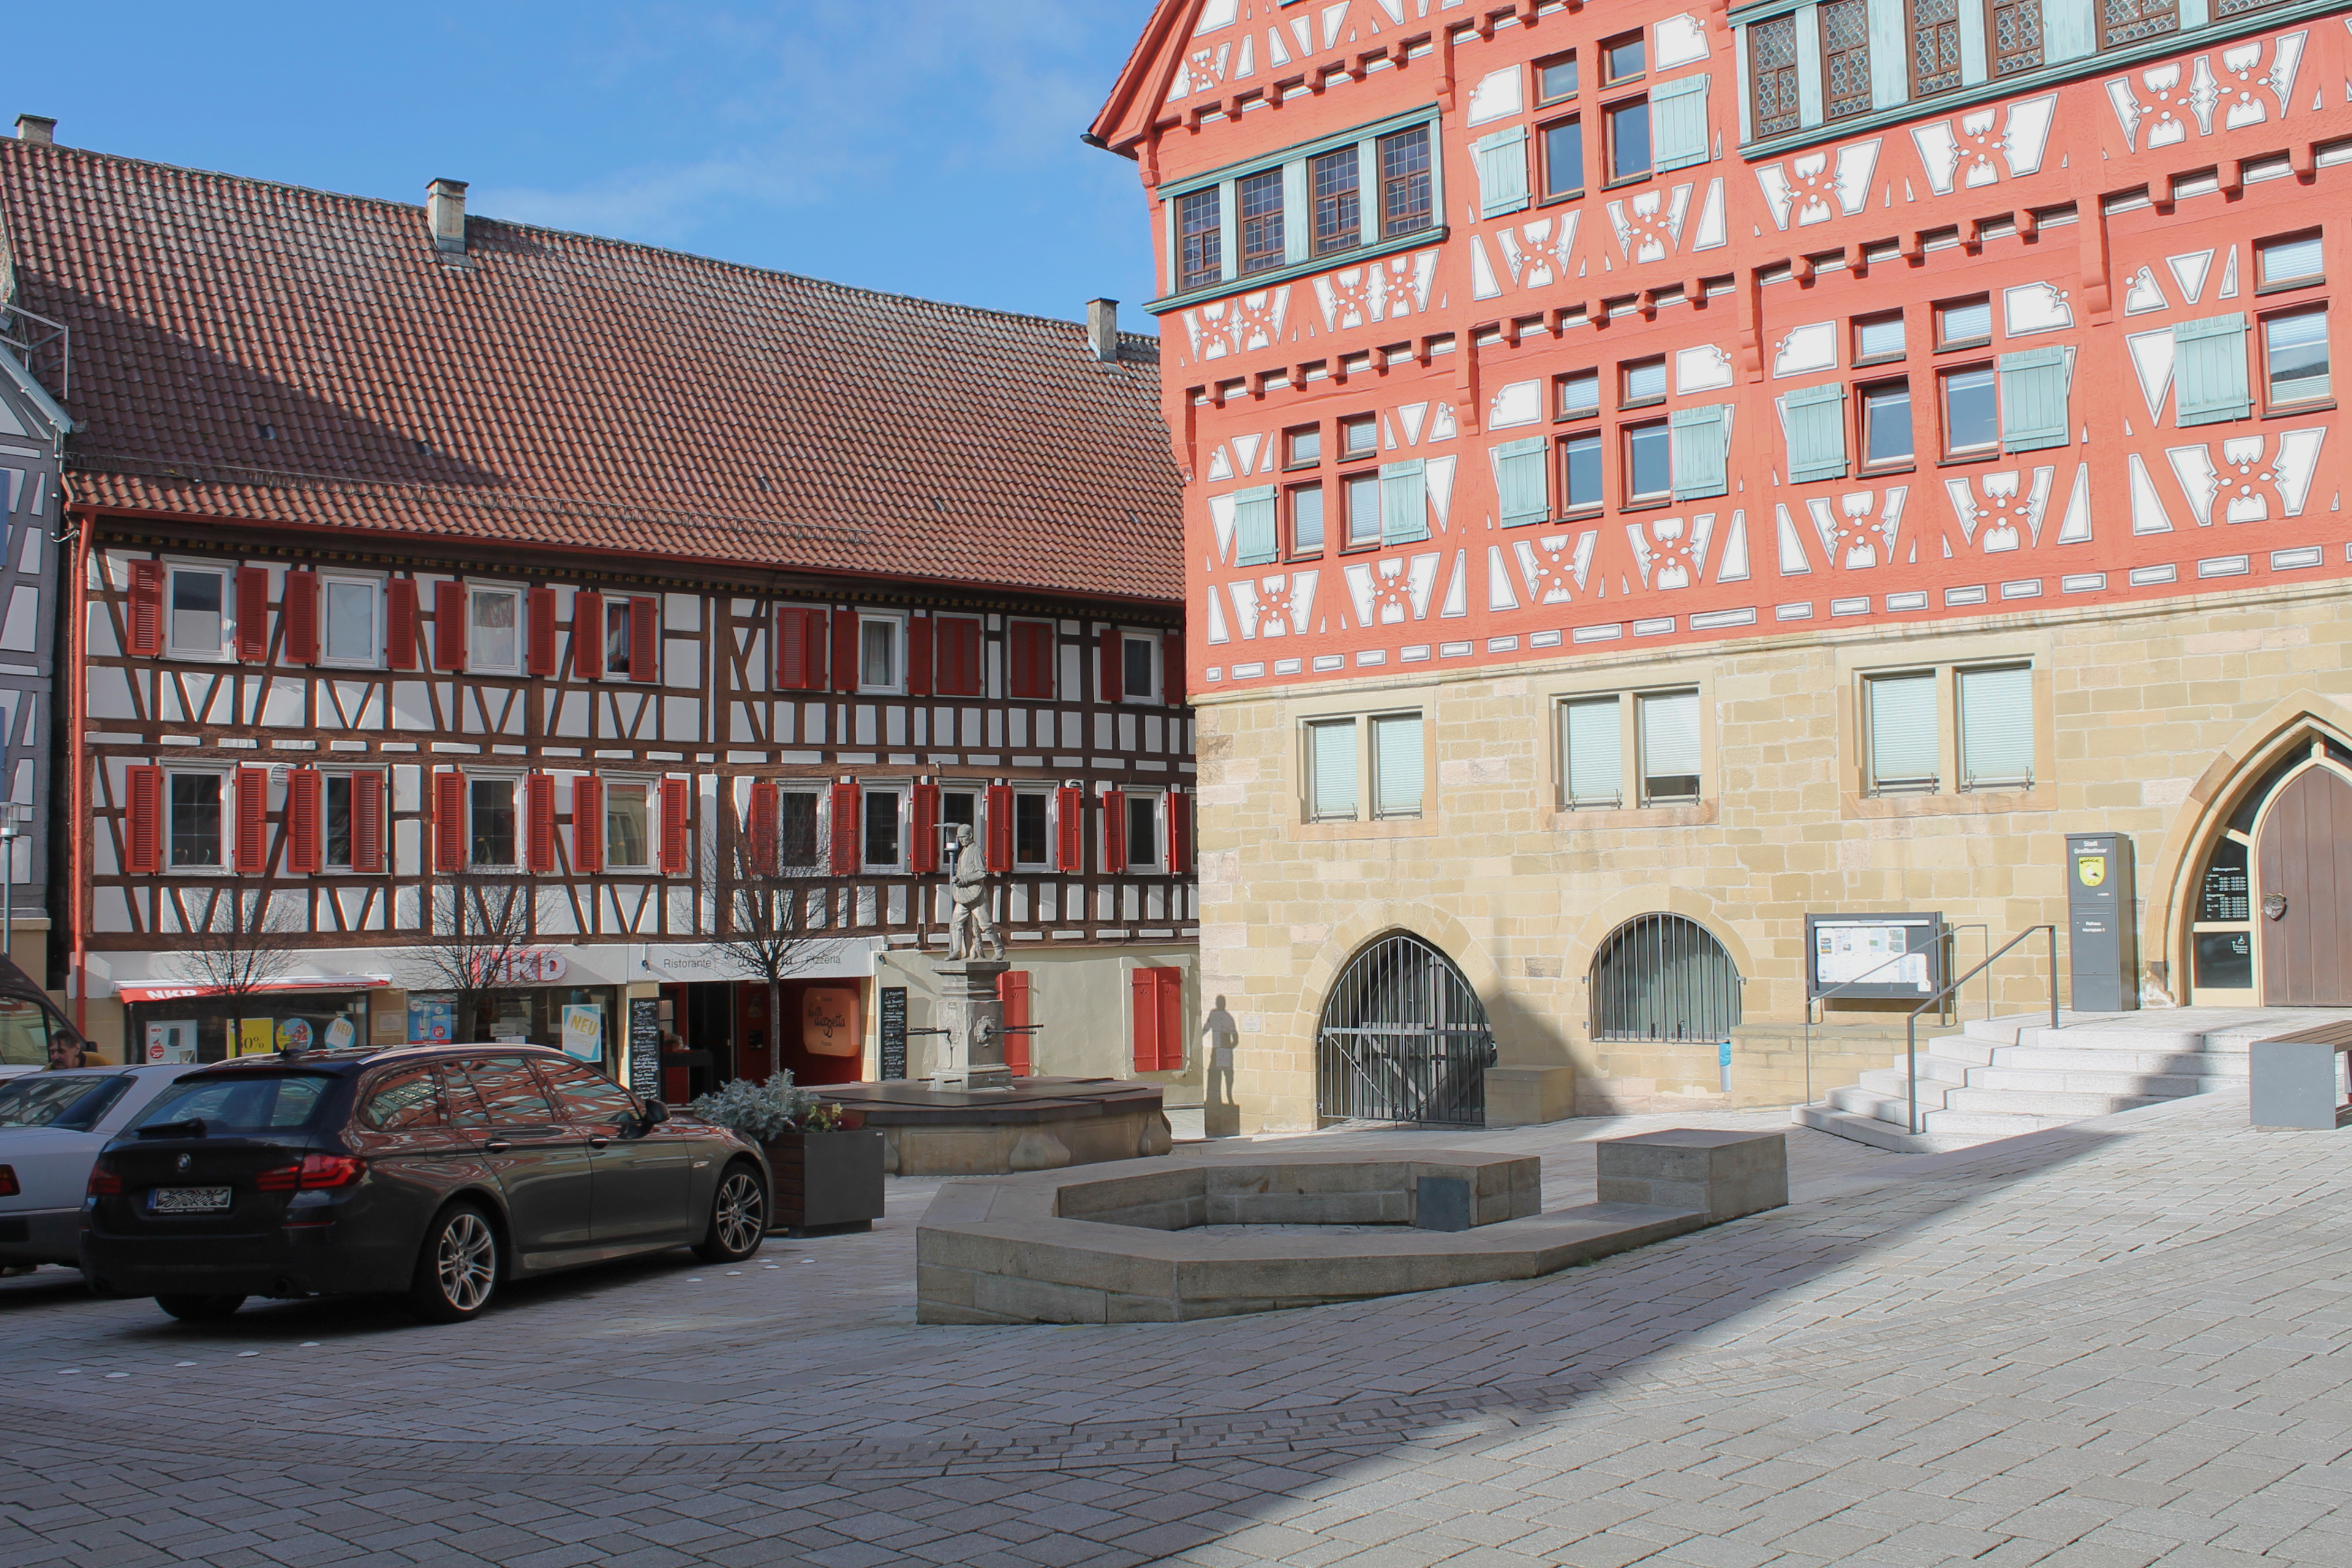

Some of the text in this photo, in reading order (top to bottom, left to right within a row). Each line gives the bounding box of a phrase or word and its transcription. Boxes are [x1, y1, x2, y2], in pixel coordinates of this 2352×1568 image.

[664, 959, 712, 968] Ristorante
[805, 954, 841, 964] Pizzeria
[146, 989, 197, 1000] NKD
[335, 1022, 352, 1036] NEU
[571, 1014, 598, 1036] NEU
[241, 1035, 265, 1050] 0%
